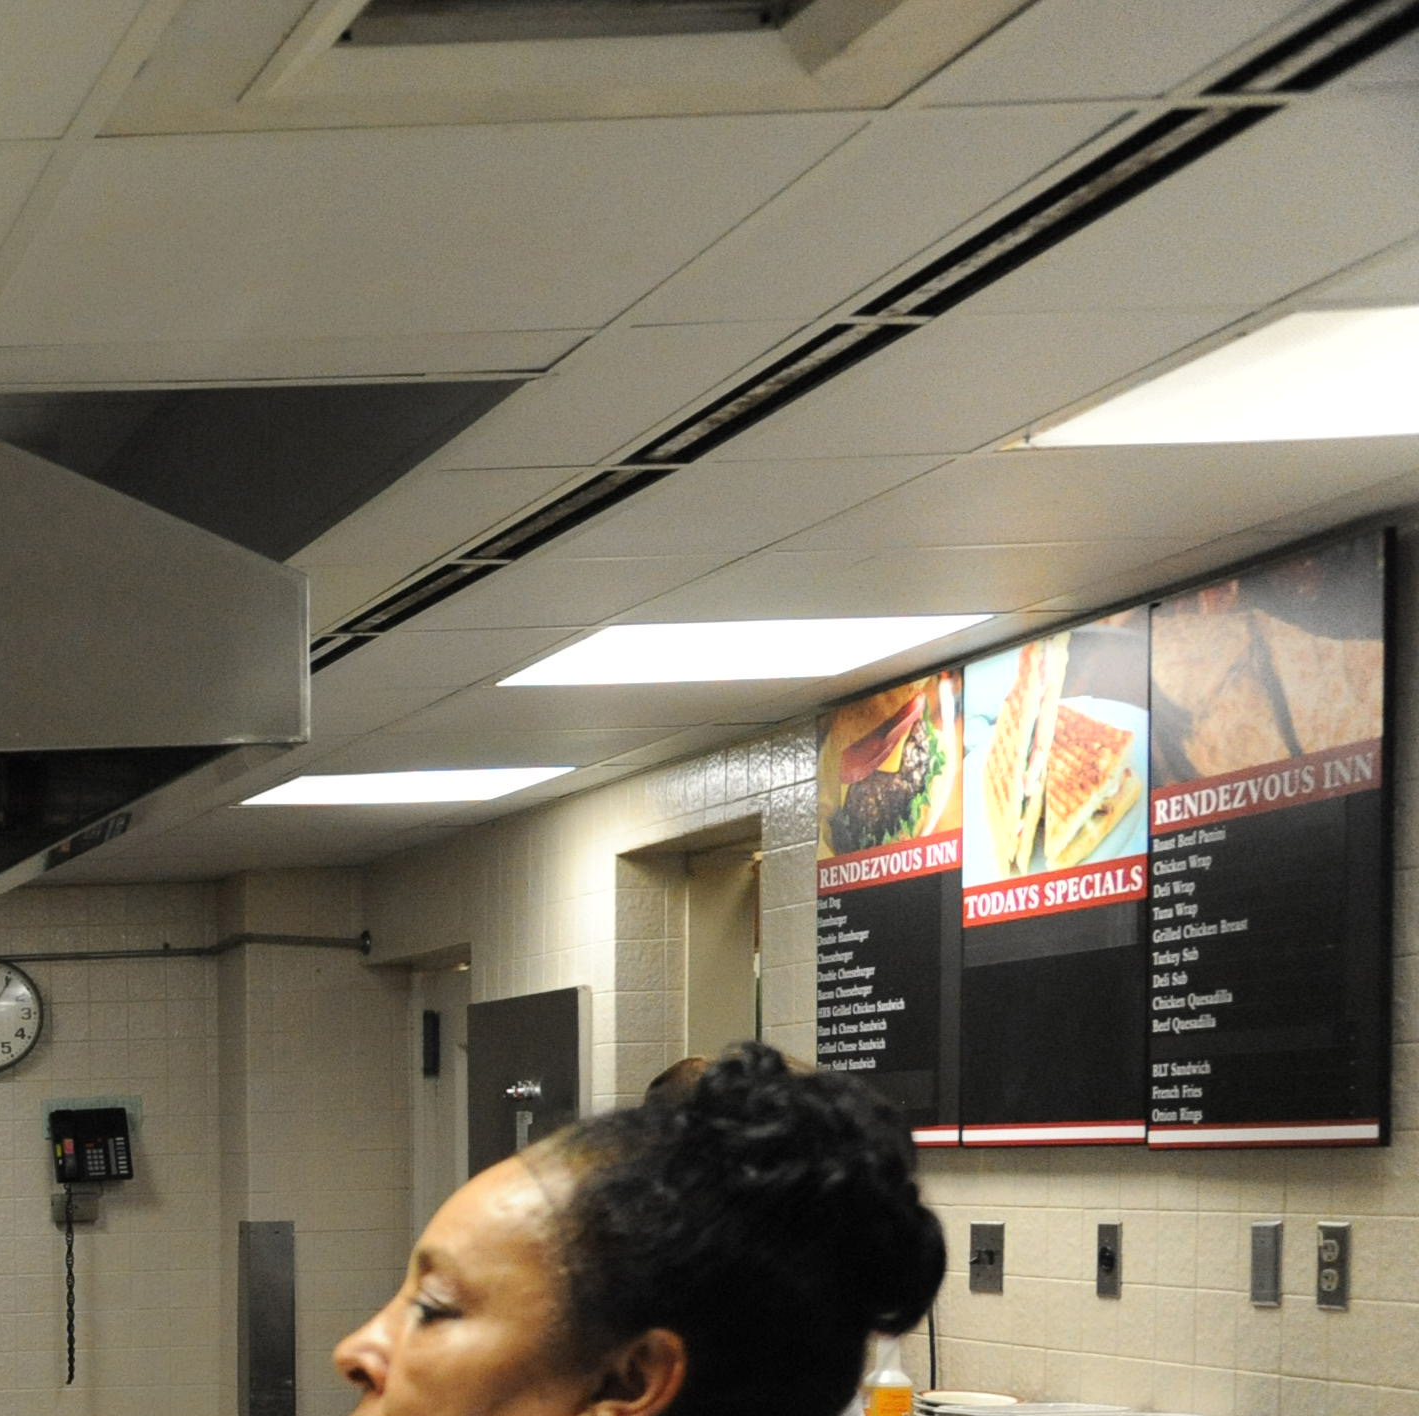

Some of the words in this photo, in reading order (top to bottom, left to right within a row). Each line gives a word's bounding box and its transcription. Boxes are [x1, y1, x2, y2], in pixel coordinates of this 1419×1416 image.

[1154, 766, 1315, 825] RENDEZVOUS
[1322, 753, 1374, 788] INN
[1177, 831, 1197, 848] Beef
[819, 848, 923, 888] RENDEZVOUS
[925, 840, 958, 867] INN
[1153, 858, 1187, 876] Chicken
[1188, 854, 1212, 870] Wrap
[964, 885, 1040, 919] TODAYS
[1044, 865, 1144, 906] SPECIALS
[1153, 882, 1171, 898] Deli
[1172, 881, 1195, 896] Wrap
[1175, 902, 1198, 918] Wrap
[1153, 925, 1182, 943] Grilled
[1183, 921, 1218, 939] Chicken
[1182, 946, 1199, 962] Sub
[1152, 973, 1170, 988] Deli
[1171, 971, 1188, 986] Sub
[1152, 995, 1186, 1010] Chicken
[1187, 989, 1233, 1010] Quesadilla
[21, 1007, 32, 1020] 3
[1152, 1017, 1171, 1032] Beef
[1172, 1013, 1217, 1034] Quesadilla
[14, 1028, 26, 1040] 4
[0, 1042, 12, 1054] 5
[1152, 1063, 1169, 1078] BLT
[1170, 1060, 1211, 1076] Sandwich
[1152, 1085, 1180, 1099] French
[1181, 1084, 1203, 1098] Fries
[1152, 1108, 1178, 1122] Onion
